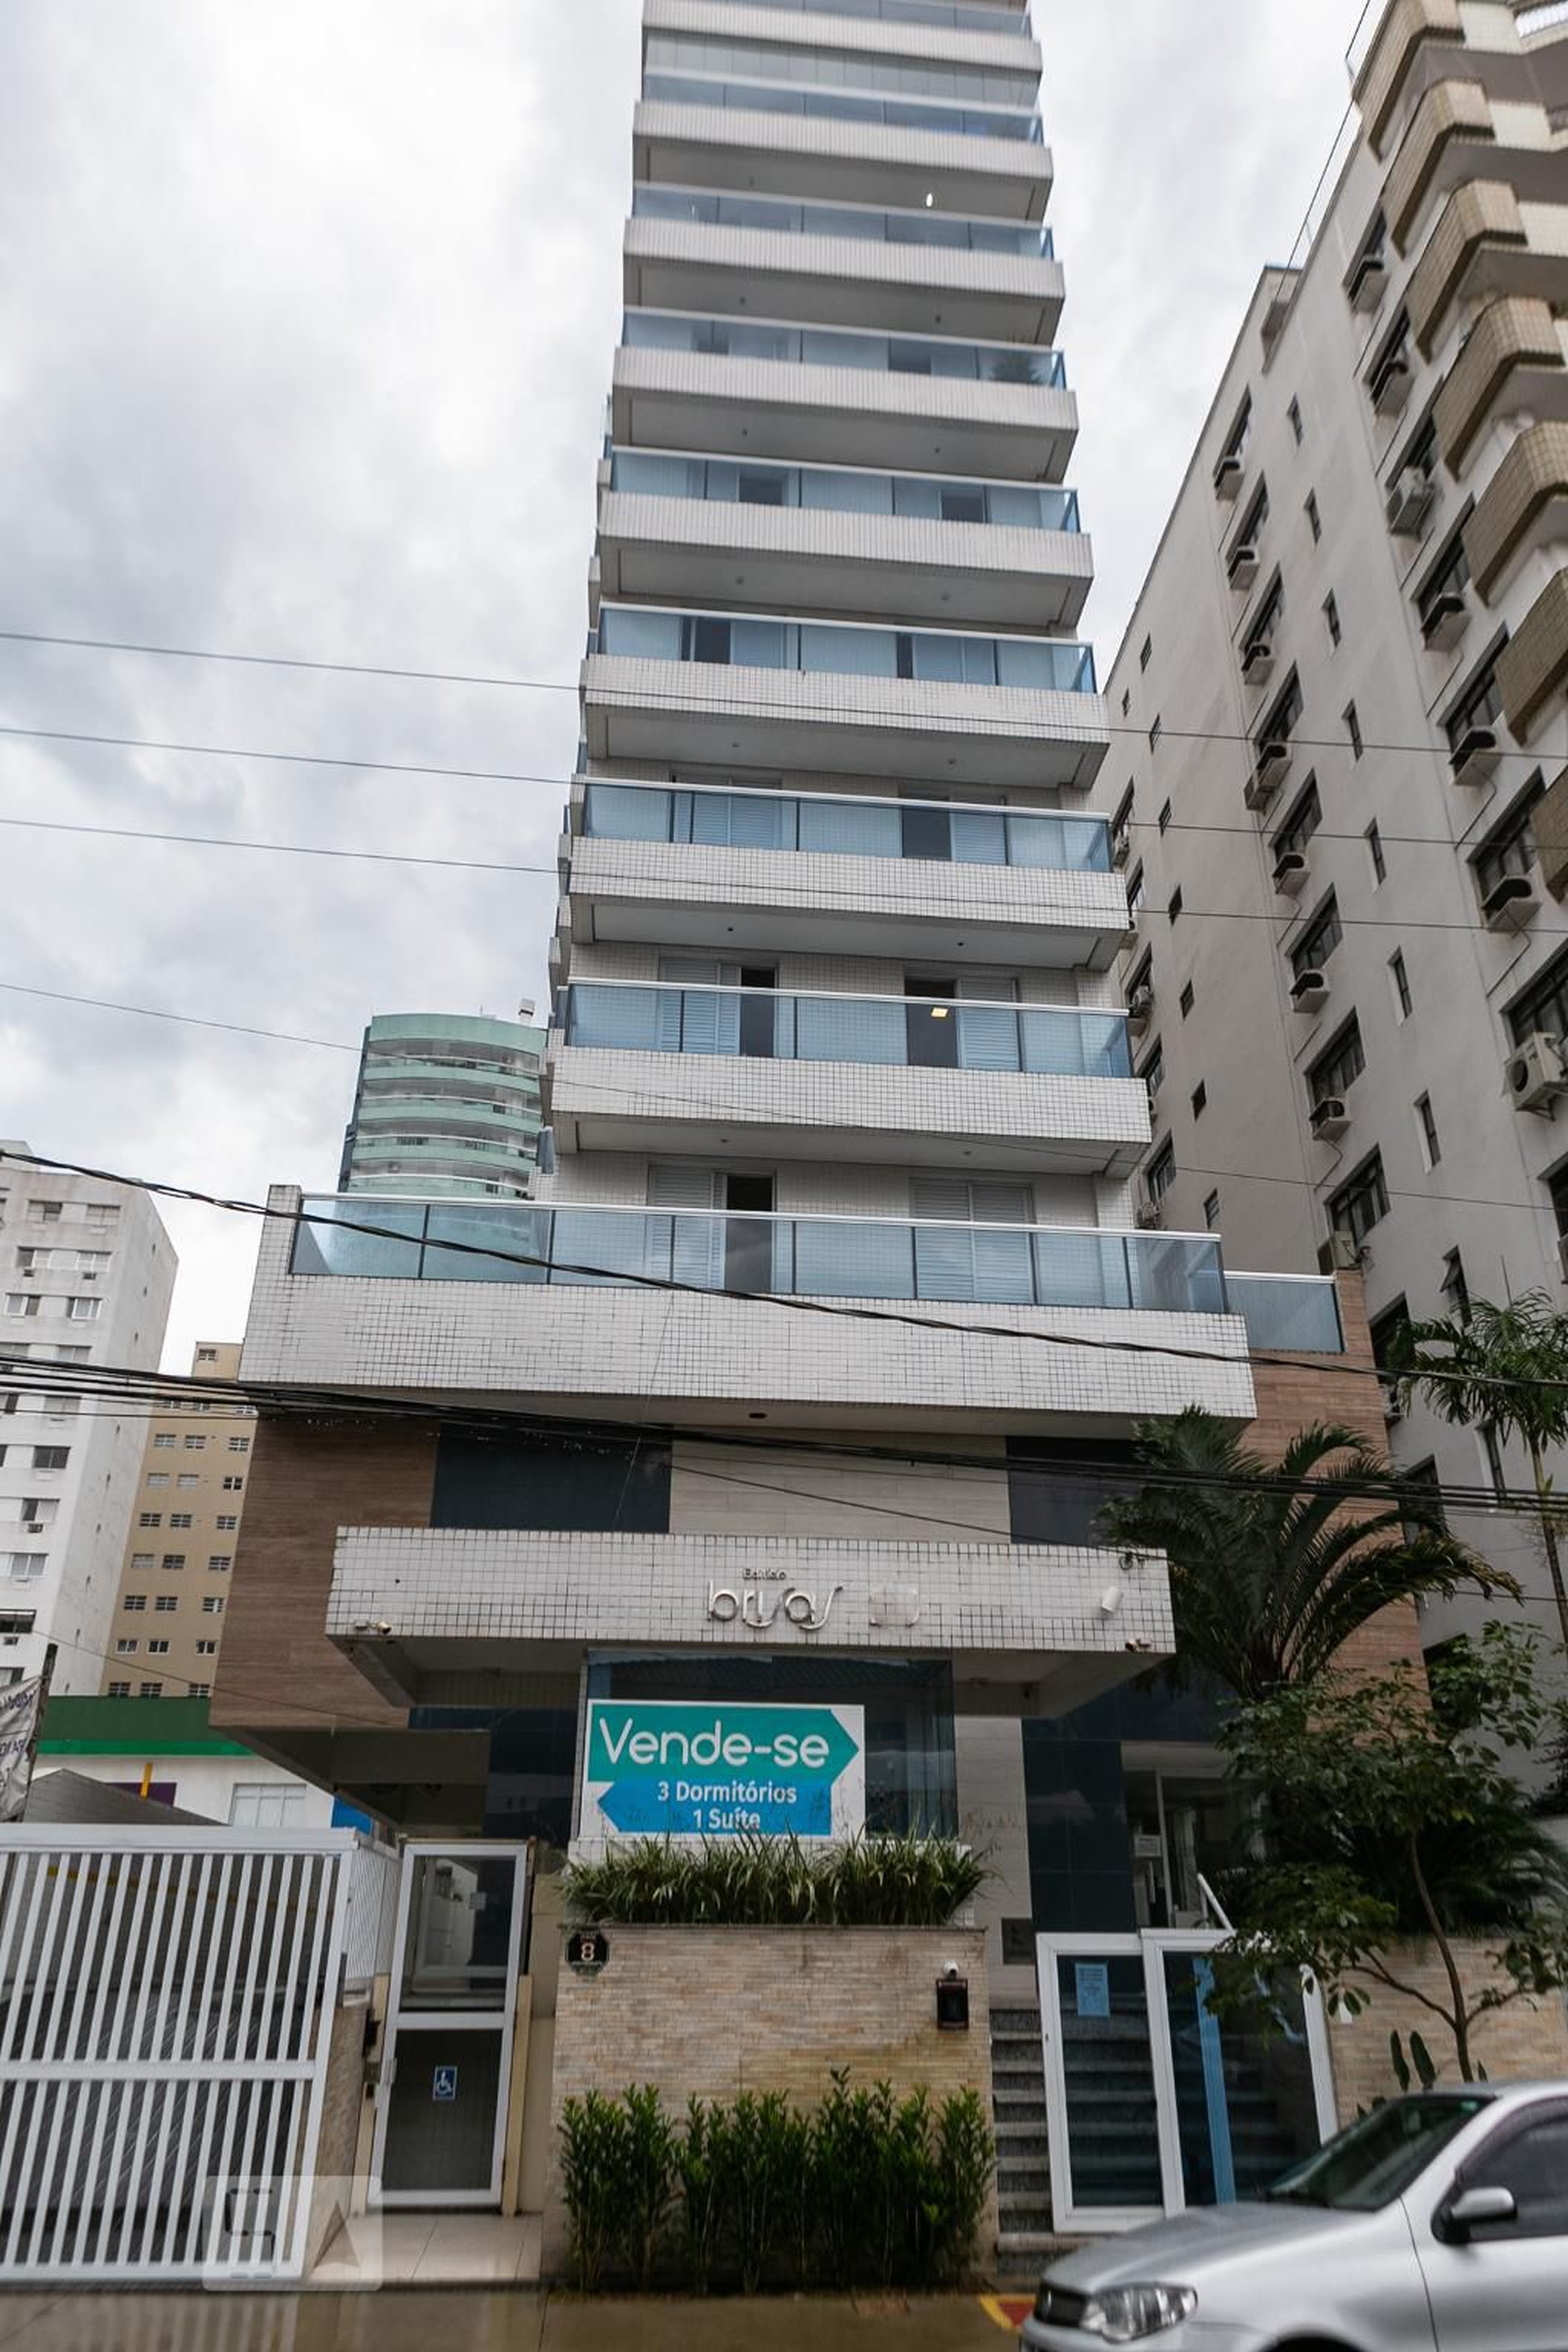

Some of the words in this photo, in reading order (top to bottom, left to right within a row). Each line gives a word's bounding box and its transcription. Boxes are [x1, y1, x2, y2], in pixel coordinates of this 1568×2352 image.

[599, 1717, 829, 1768] Vende-se
[658, 1781, 669, 1802] 3
[676, 1780, 797, 1803] Dormitórios
[693, 1809, 702, 1828] 1
[581, 1942, 595, 1961] 8
